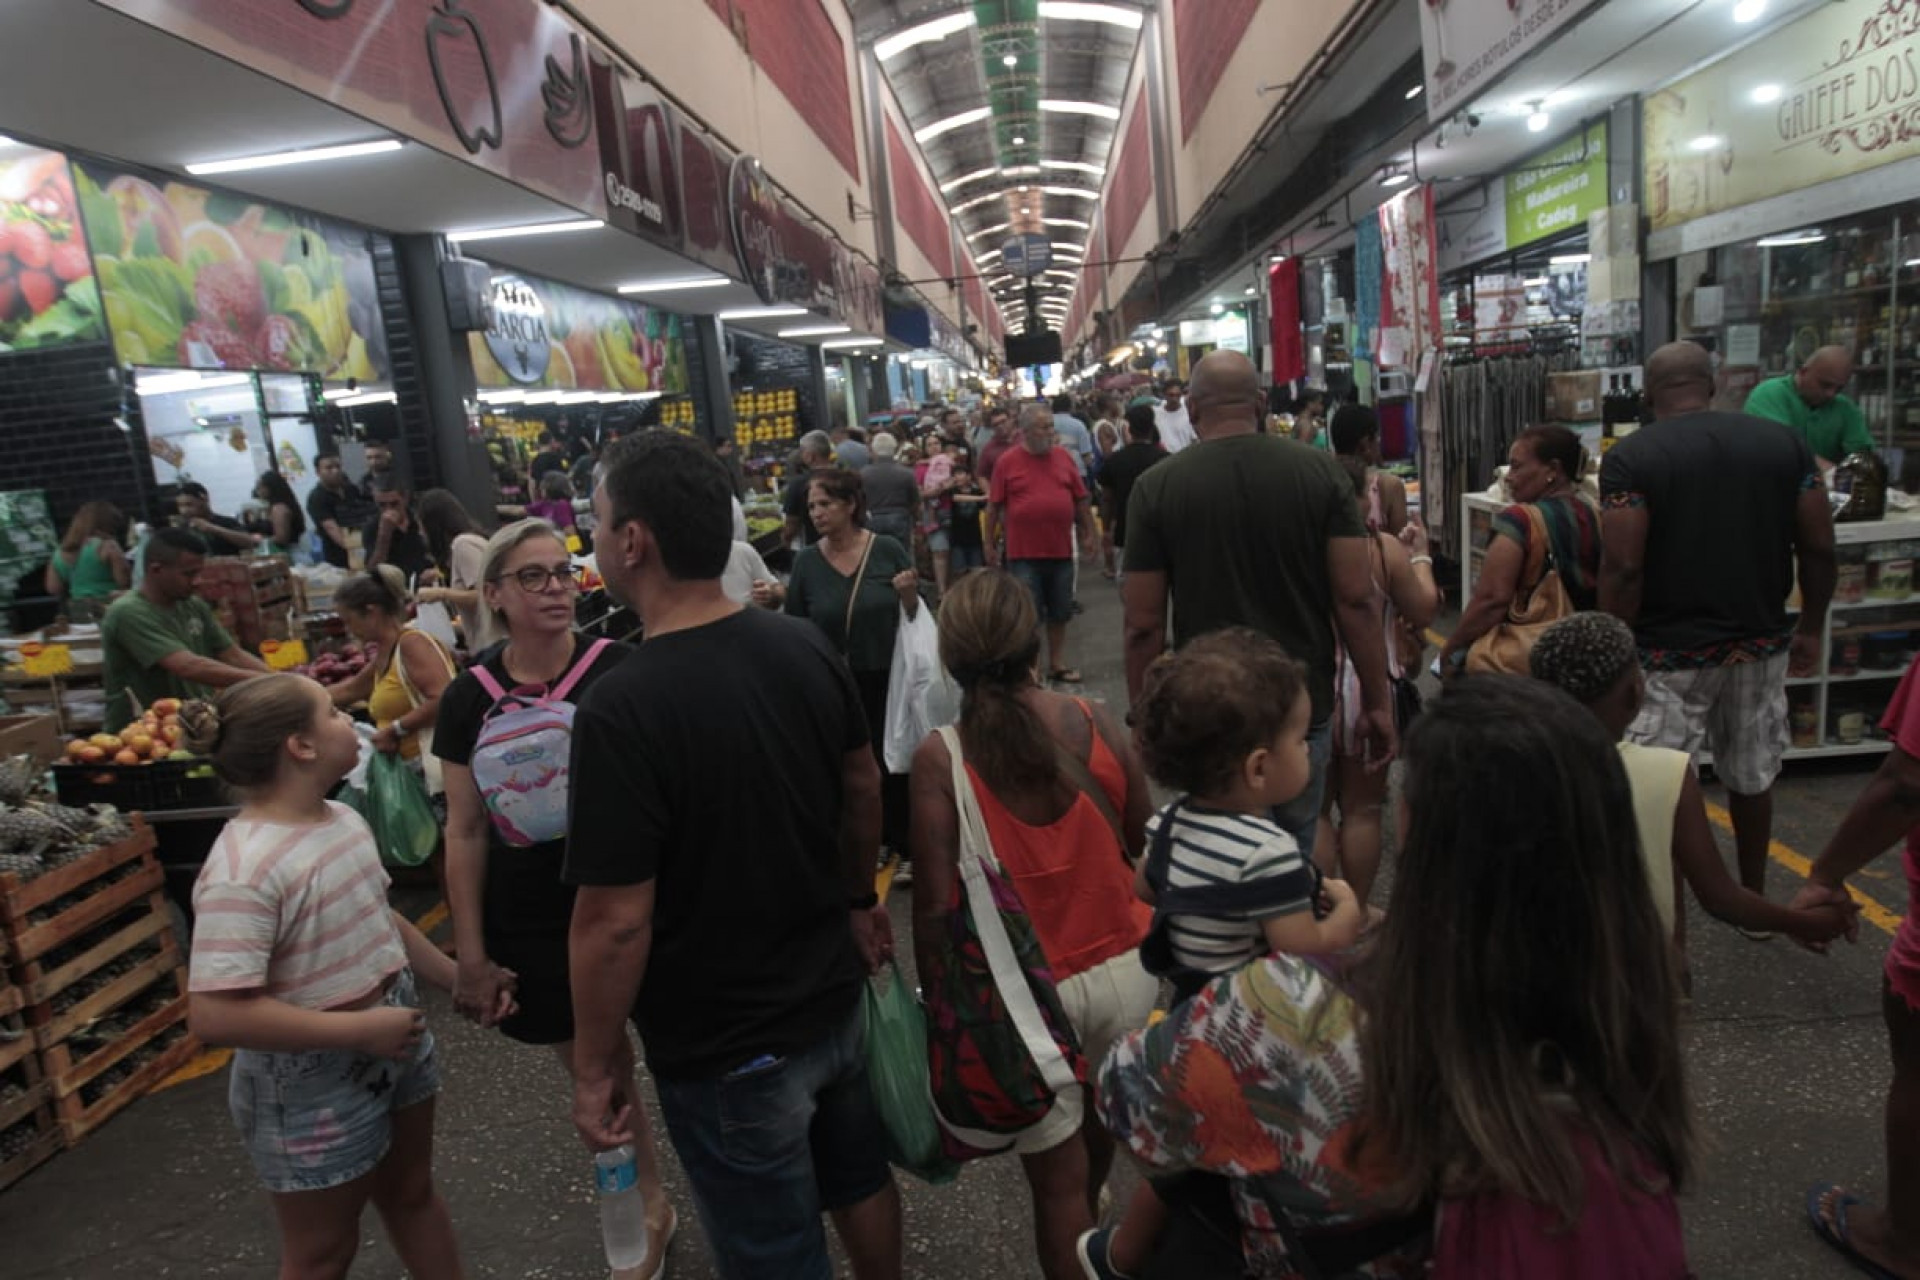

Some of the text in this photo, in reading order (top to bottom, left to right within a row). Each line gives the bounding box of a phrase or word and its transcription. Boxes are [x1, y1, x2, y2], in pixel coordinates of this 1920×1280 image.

[1777, 46, 1918, 141] GRIFFE DOS
[1526, 172, 1590, 211] Madureira
[1537, 203, 1578, 231] Cadeg
